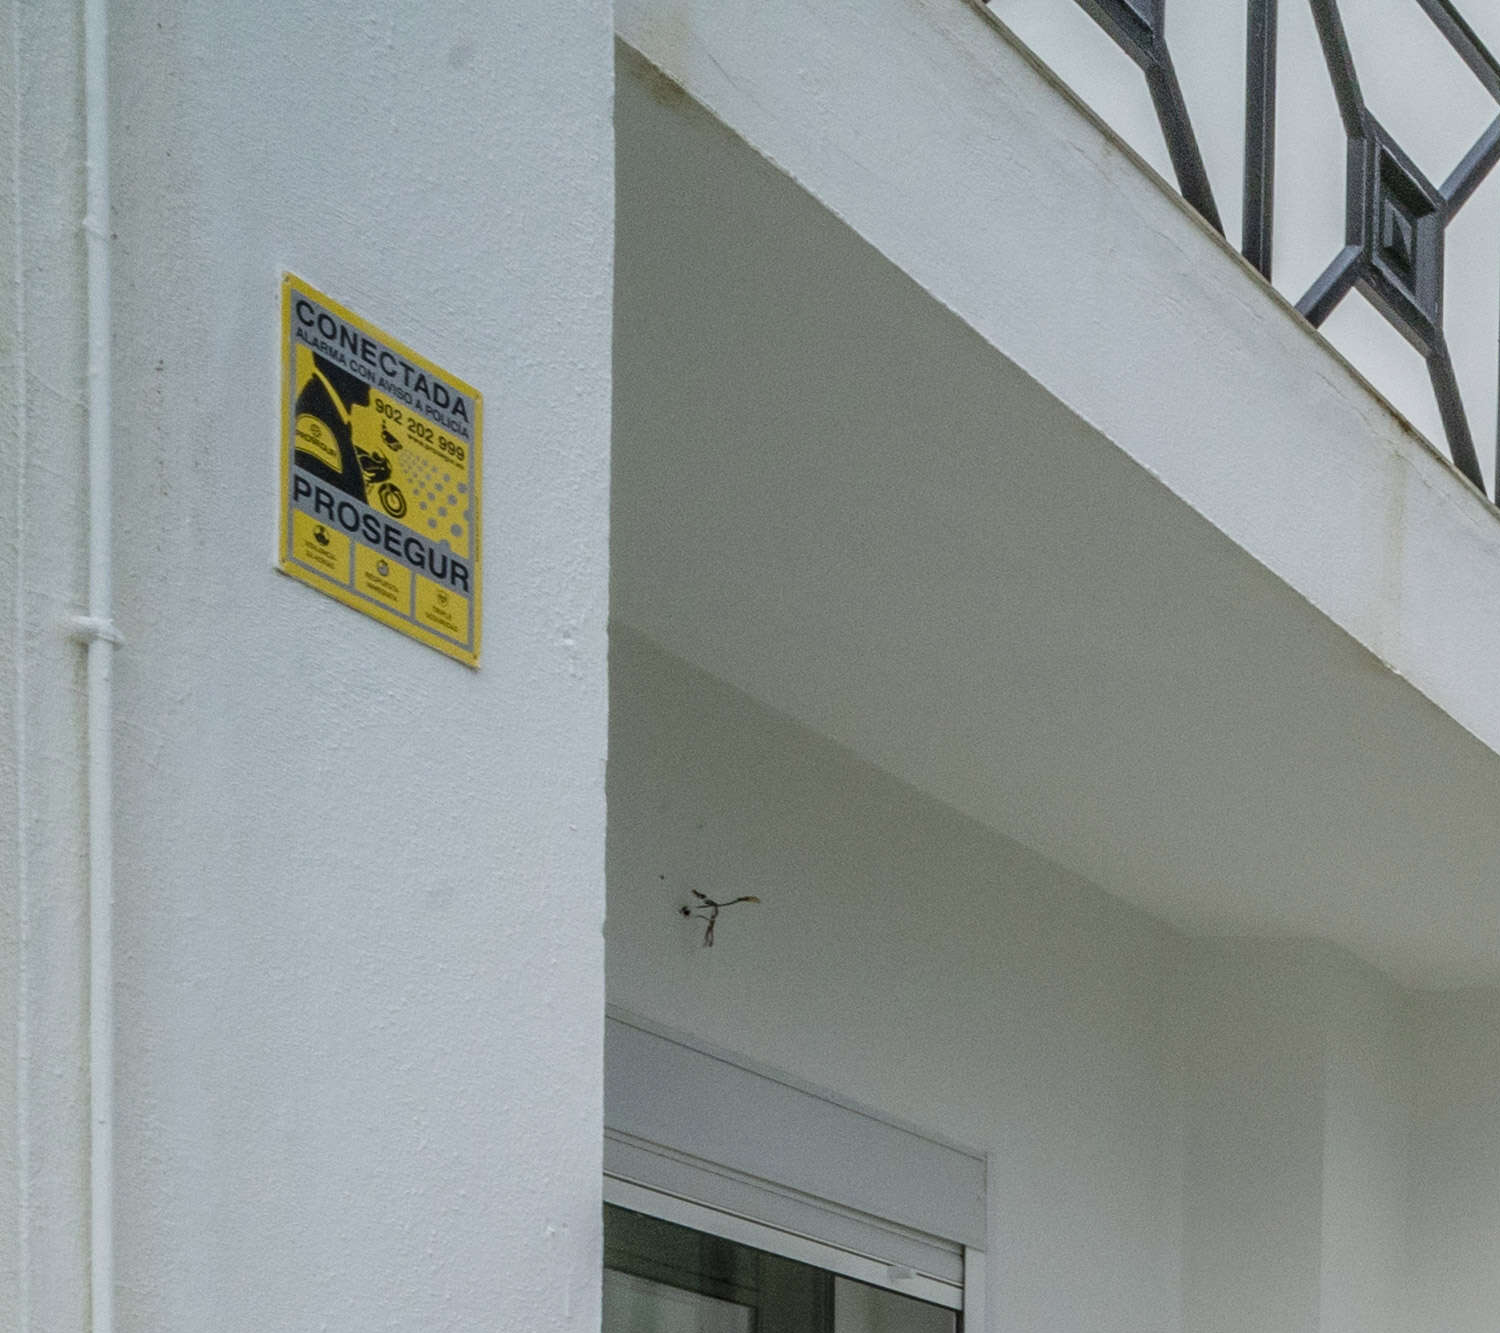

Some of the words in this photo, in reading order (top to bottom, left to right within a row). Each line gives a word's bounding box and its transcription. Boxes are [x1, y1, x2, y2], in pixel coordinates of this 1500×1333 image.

[295, 328, 347, 367] ALARMA
[346, 360, 376, 383] CON
[378, 375, 413, 404] AVISO
[414, 400, 424, 413] A
[296, 300, 469, 423] CONECTADA
[375, 398, 403, 425] 902
[407, 418, 434, 444] 202
[438, 435, 465, 461] 999
[294, 475, 469, 593] PROSEGUR
